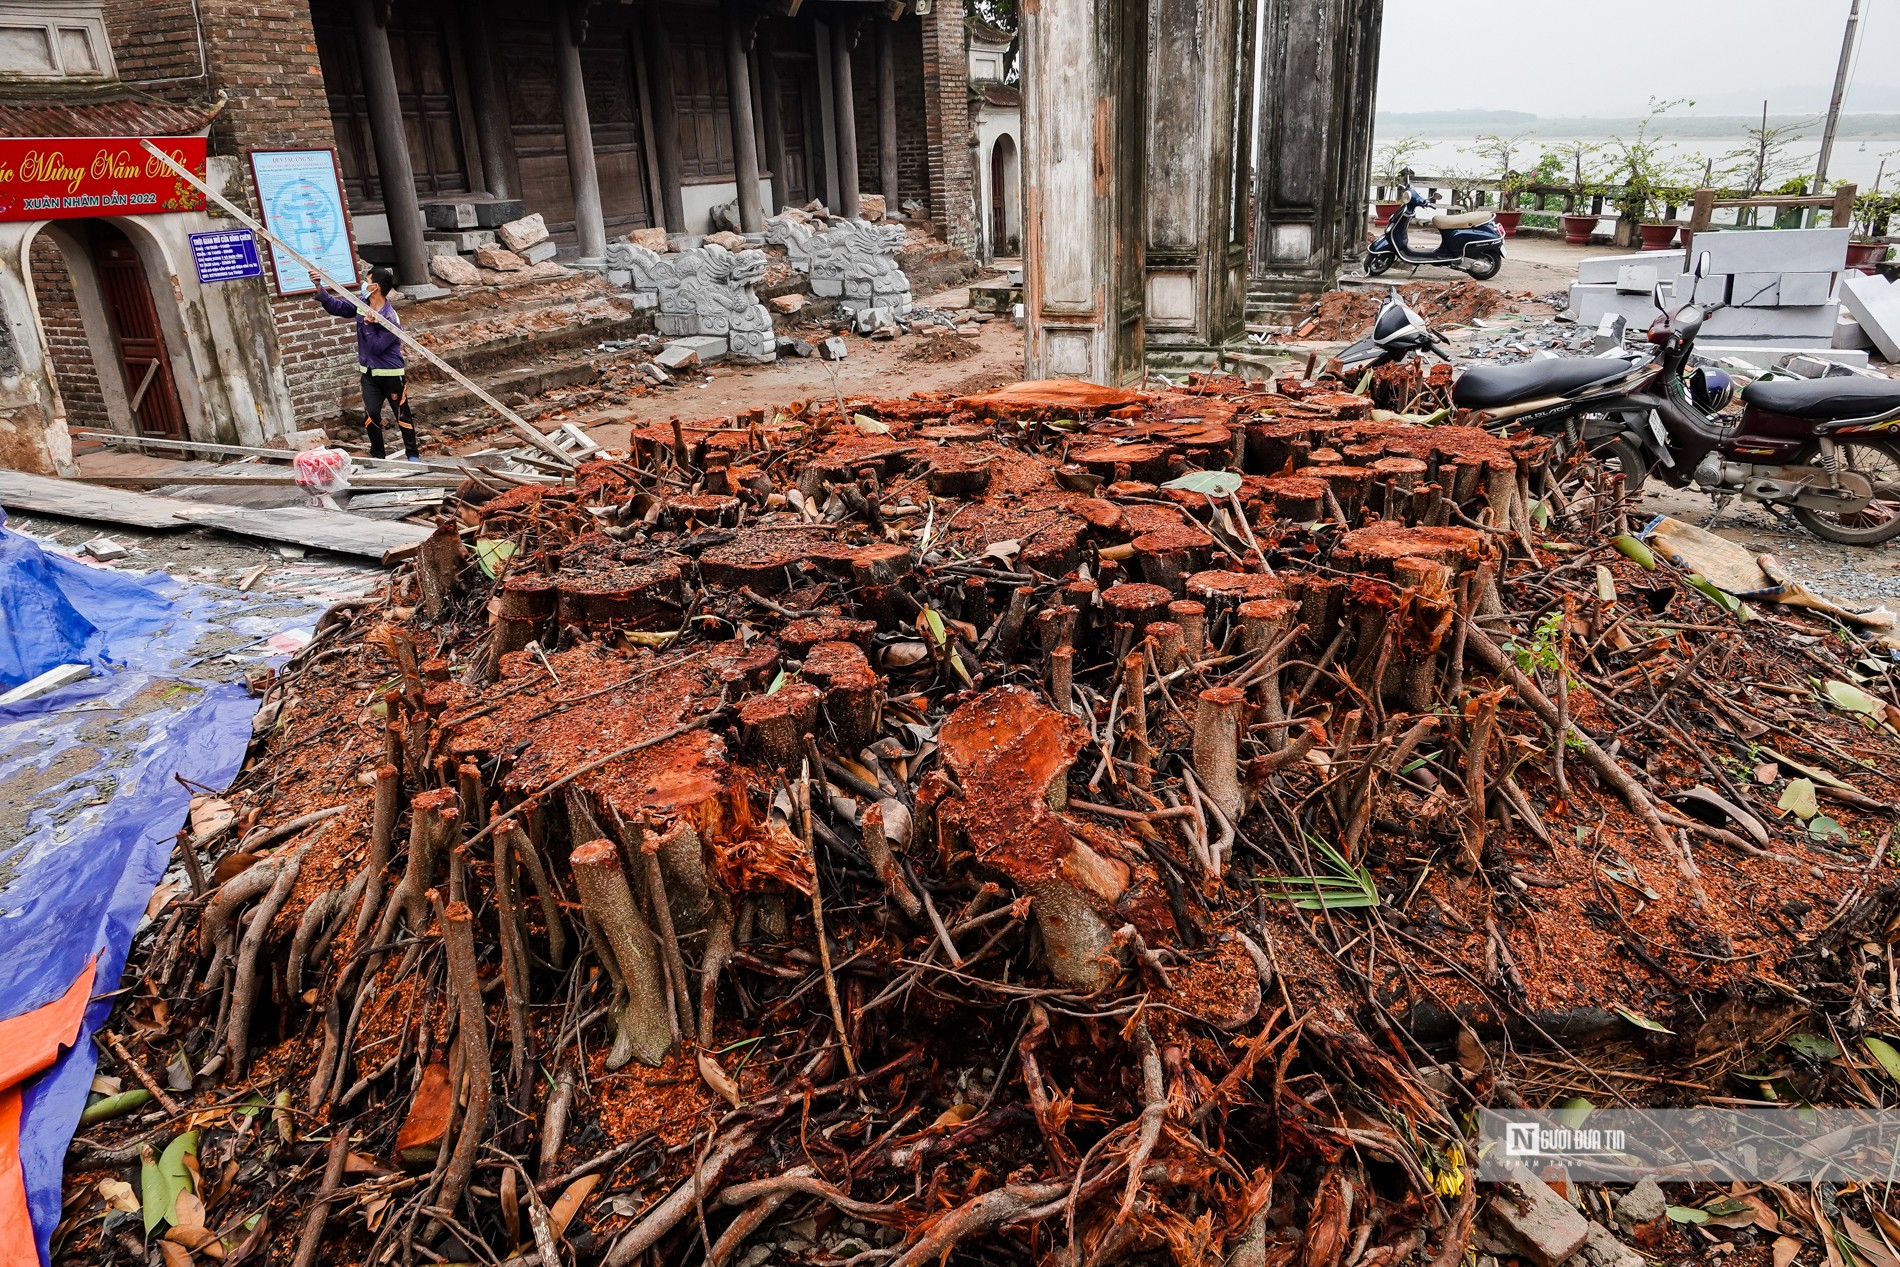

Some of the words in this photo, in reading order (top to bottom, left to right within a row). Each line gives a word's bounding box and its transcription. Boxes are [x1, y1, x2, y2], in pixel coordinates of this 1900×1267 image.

[19, 150, 86, 194] Mừng
[90, 149, 141, 180] Năm
[23, 196, 60, 210] XUÂN
[63, 194, 100, 208] NHÂM
[130, 193, 157, 204] 2022
